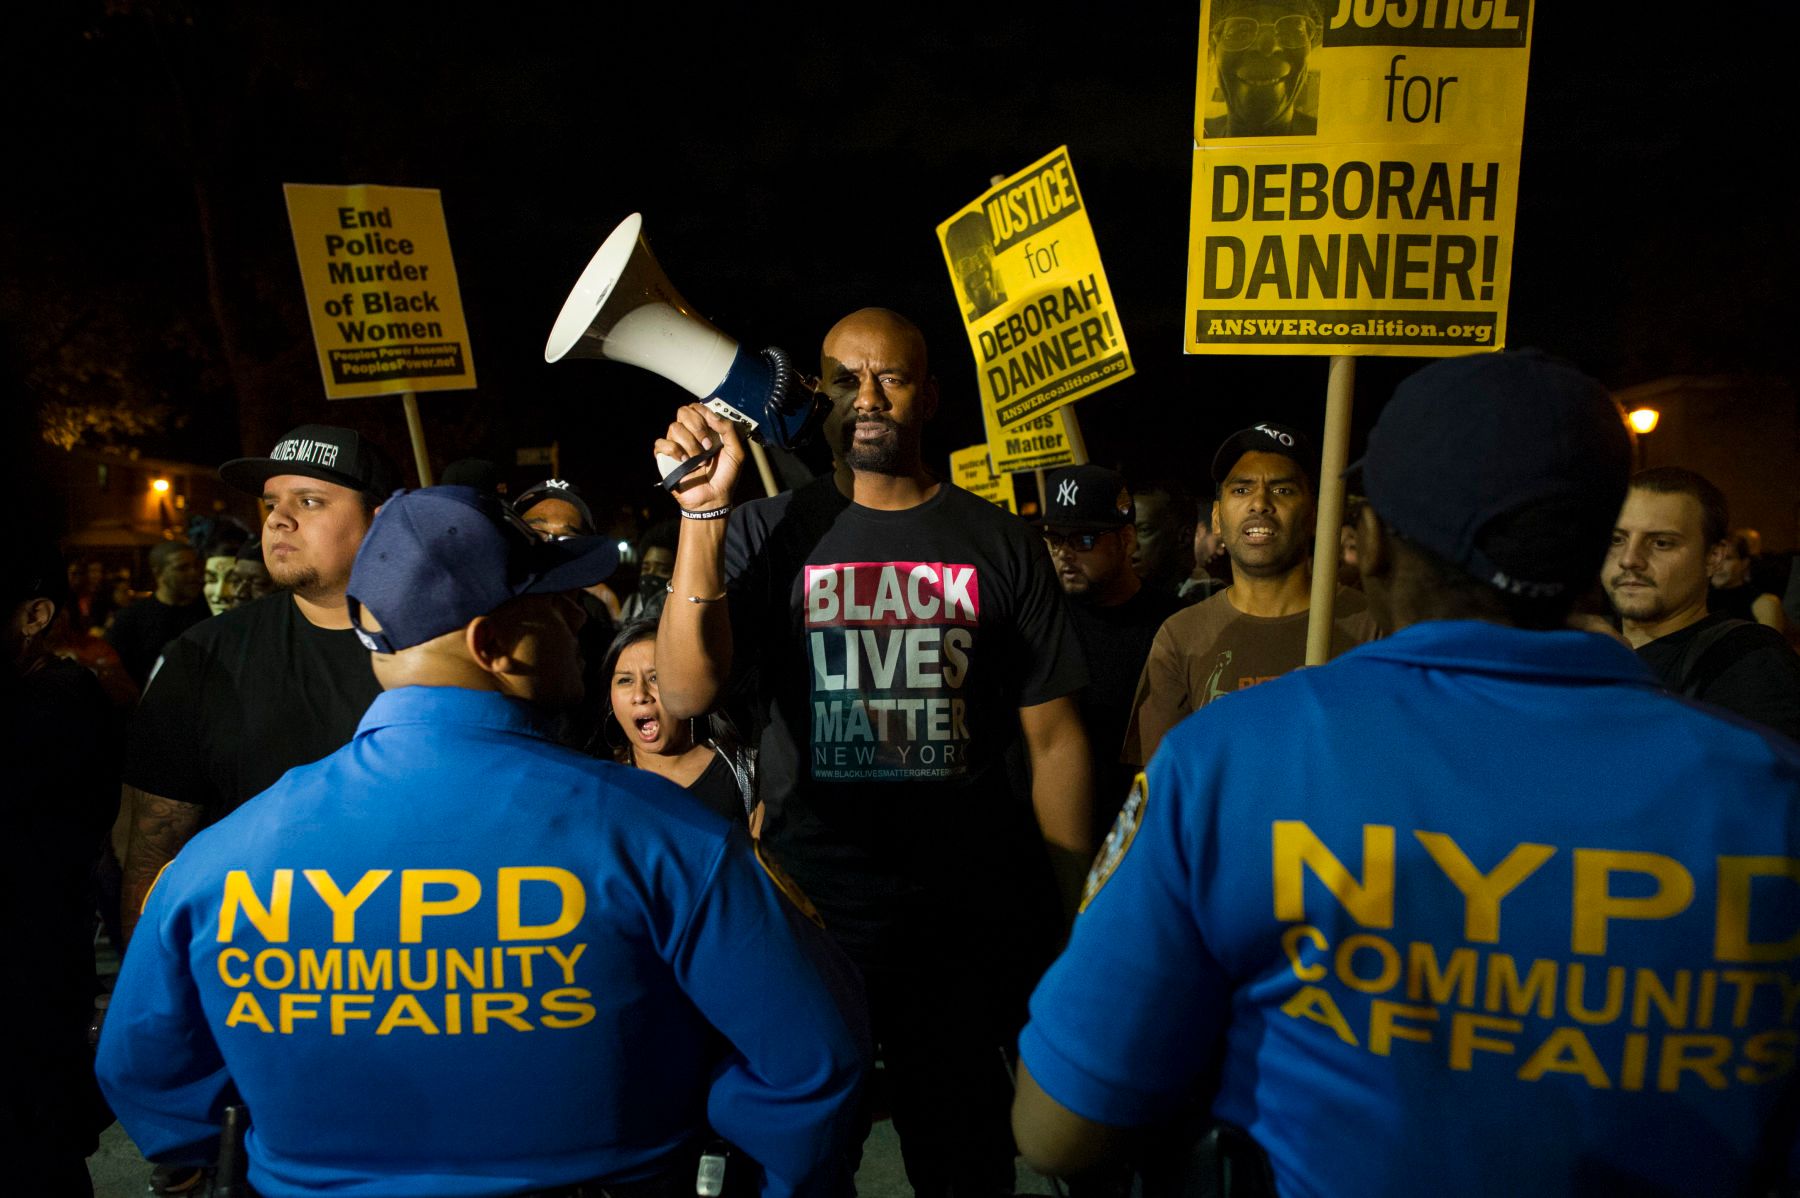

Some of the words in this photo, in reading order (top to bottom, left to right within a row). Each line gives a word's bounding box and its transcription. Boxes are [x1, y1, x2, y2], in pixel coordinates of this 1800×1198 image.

[1384, 54, 1458, 124] for
[986, 159, 1075, 247] JUSTICE
[1211, 161, 1499, 222] DEBORAH
[338, 206, 393, 230] End
[325, 232, 414, 257] Police
[1024, 239, 1060, 279] for
[1203, 233, 1498, 300] DANNER!
[327, 261, 429, 285] Murder
[324, 293, 355, 317] of
[363, 291, 440, 315] Black
[978, 273, 1103, 363] DEBORAH
[336, 321, 443, 343] Women
[1207, 319, 1492, 342] ANSWERcoalition.org
[987, 311, 1118, 404] DANNER!
[1001, 358, 1126, 421] ANSWERcoalition.org
[295, 439, 339, 468] MATTER
[1006, 433, 1063, 455] Matter
[1056, 478, 1080, 507] NY
[808, 564, 977, 623] BLACK
[810, 627, 973, 692] LIVES
[814, 698, 971, 743] MATTER
[815, 745, 877, 766] NEW
[216, 865, 586, 944] NYPD
[1271, 819, 1800, 963] NYPD
[217, 943, 588, 991] COMMUNITY
[225, 987, 597, 1036] AFFAIRS
[1280, 984, 1798, 1092] AFFAIRS
